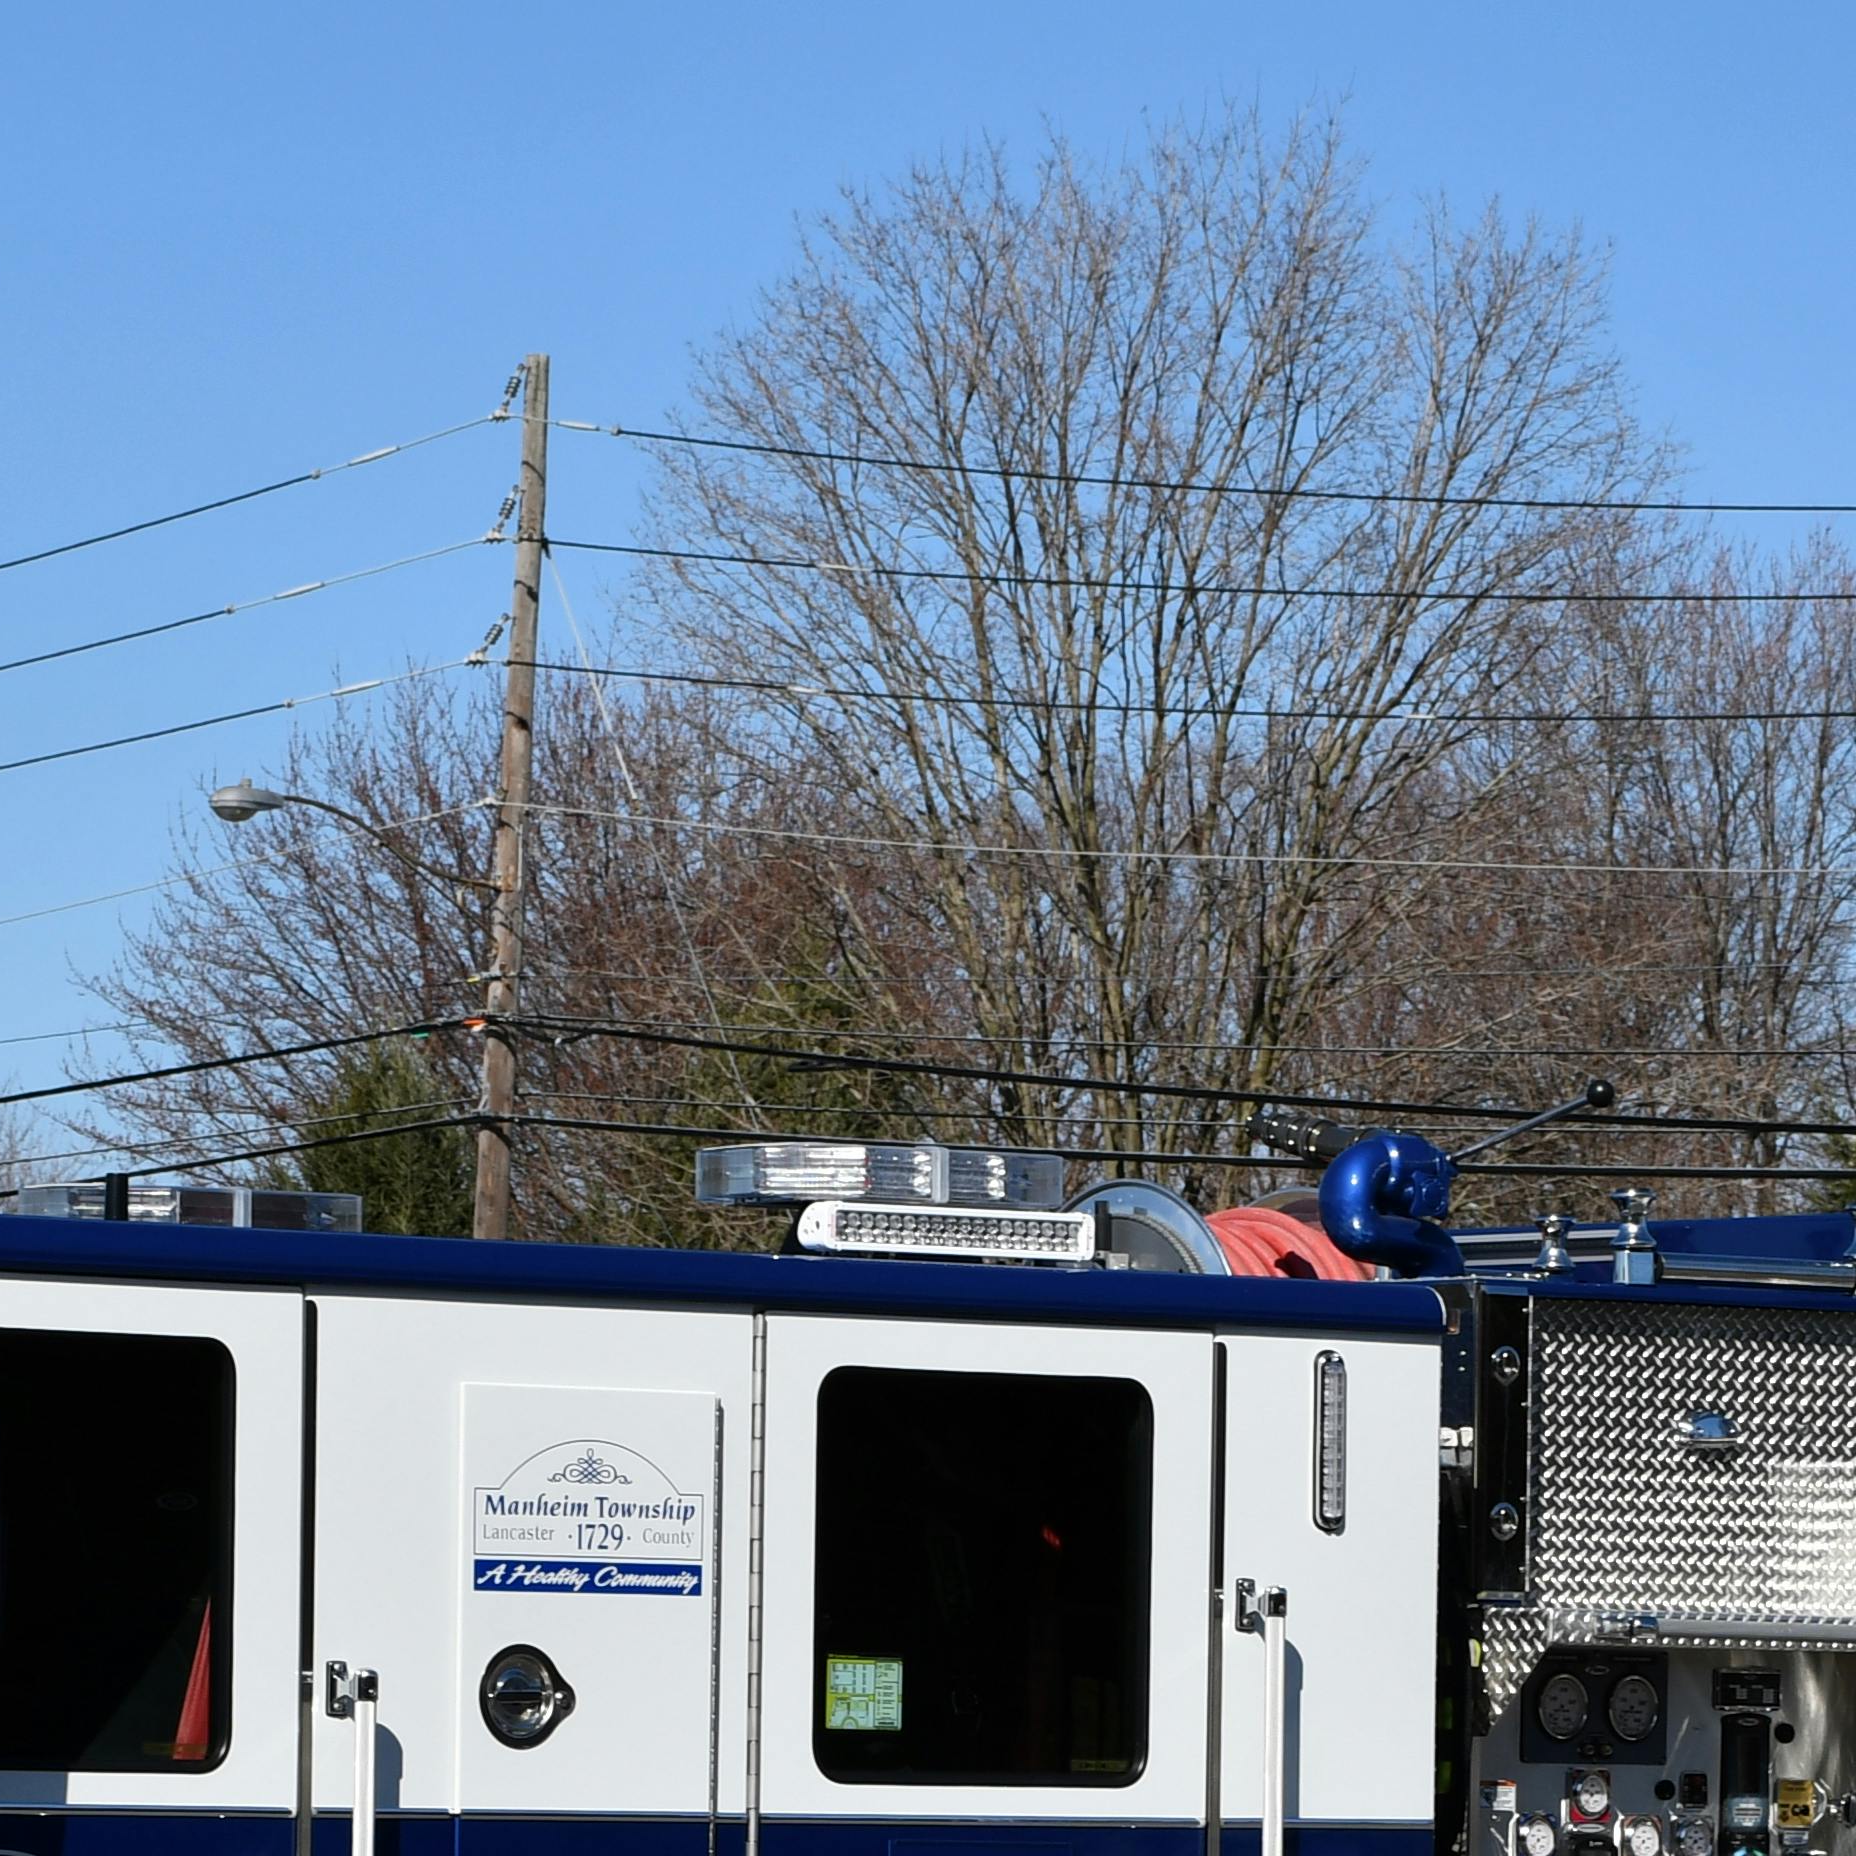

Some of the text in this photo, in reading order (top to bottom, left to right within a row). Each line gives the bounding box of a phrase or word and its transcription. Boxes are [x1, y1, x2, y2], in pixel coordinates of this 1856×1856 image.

[484, 1492, 696, 1526] Manheim Township
[482, 1523, 695, 1551] Lancaster 1729 County
[477, 1563, 699, 1595] A Healthy Community
